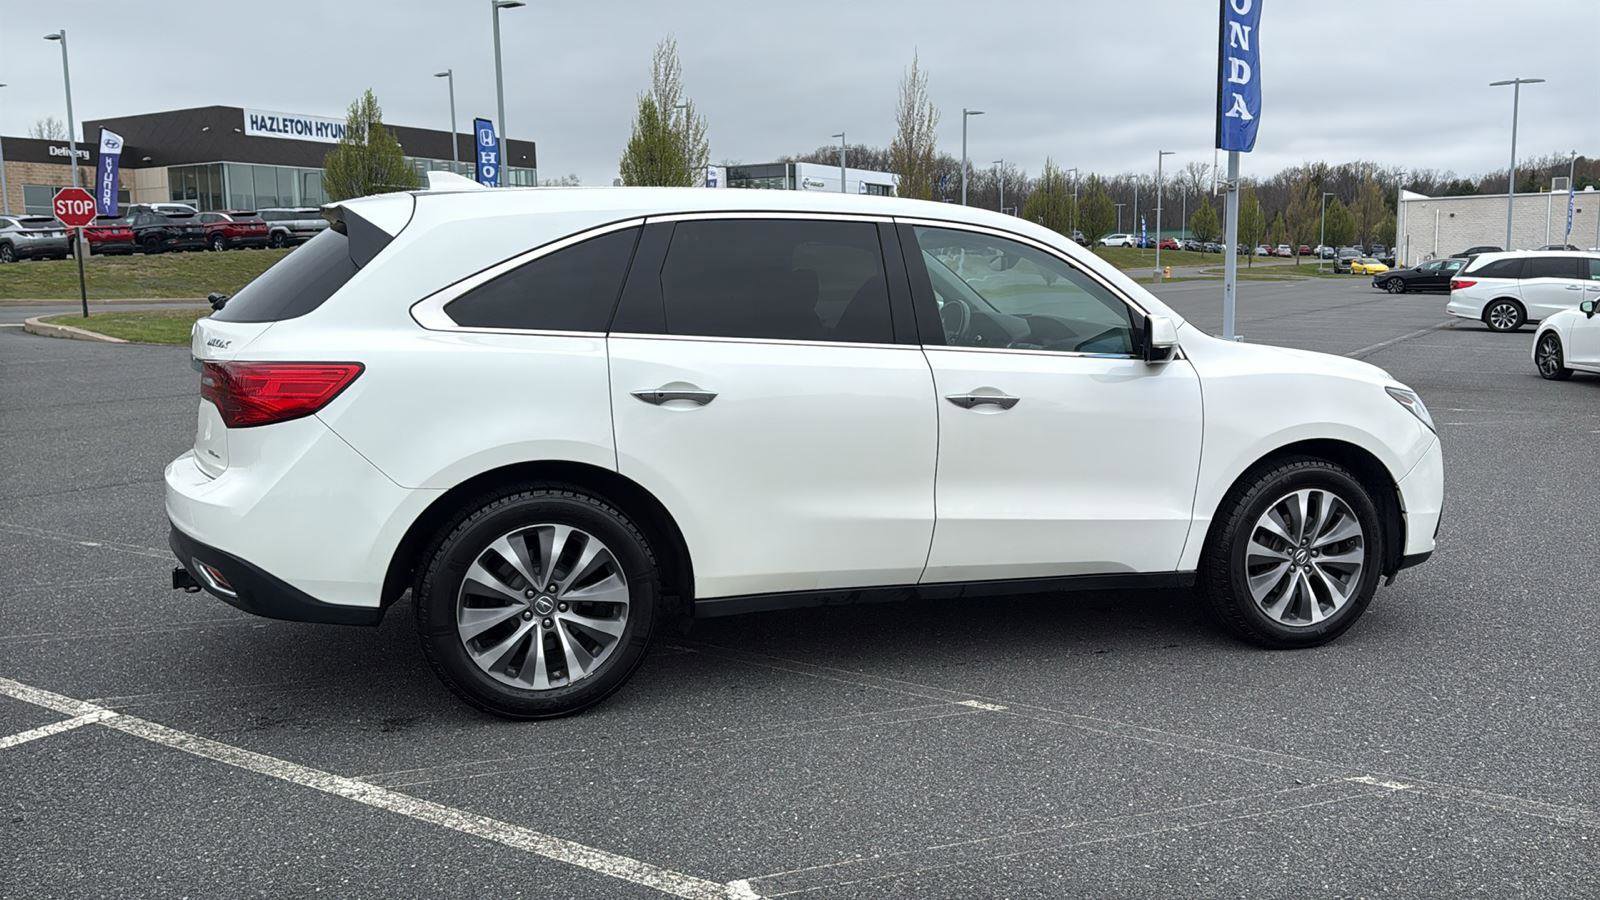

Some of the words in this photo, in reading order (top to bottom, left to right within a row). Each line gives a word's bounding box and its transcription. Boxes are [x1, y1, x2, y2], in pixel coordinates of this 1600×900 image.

[250, 114, 312, 137] HAZLETON
[102, 156, 113, 213] HYUNDAI
[56, 199, 93, 215] STOP
